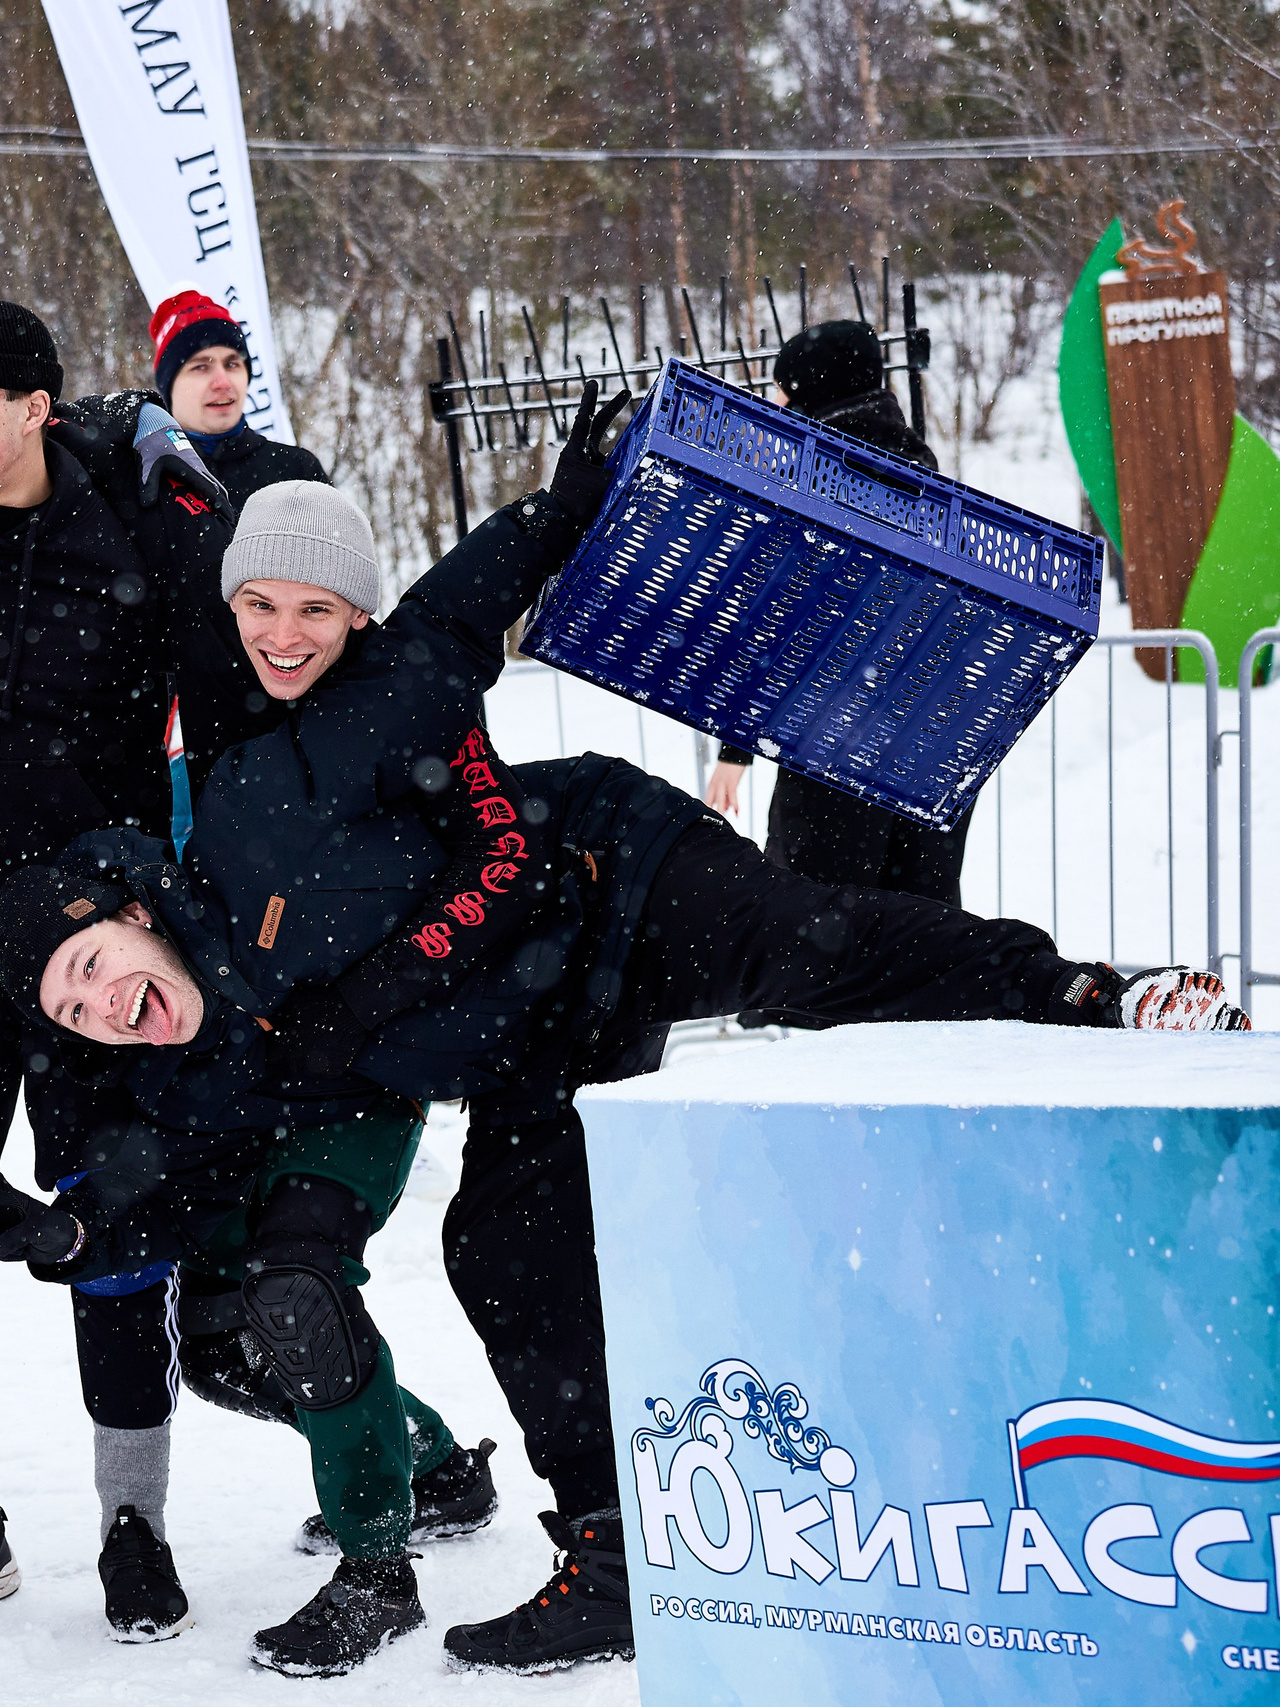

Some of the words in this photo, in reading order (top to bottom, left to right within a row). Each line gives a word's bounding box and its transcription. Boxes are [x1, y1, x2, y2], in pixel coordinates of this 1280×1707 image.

[118, 0, 208, 121] МАУ
[175, 144, 232, 264] ГСЦ
[1105, 291, 1223, 326] ПРИЯТНОЙ
[410, 727, 531, 959] MADNESS
[264, 902, 281, 937] Columbia
[1063, 972, 1090, 1003] PALLADIUM
[650, 1594, 762, 1628] РОССИЯ,
[764, 1605, 962, 1645] МУРМАНСКАЯ
[965, 1623, 1100, 1658] ОБЛАСТЬ
